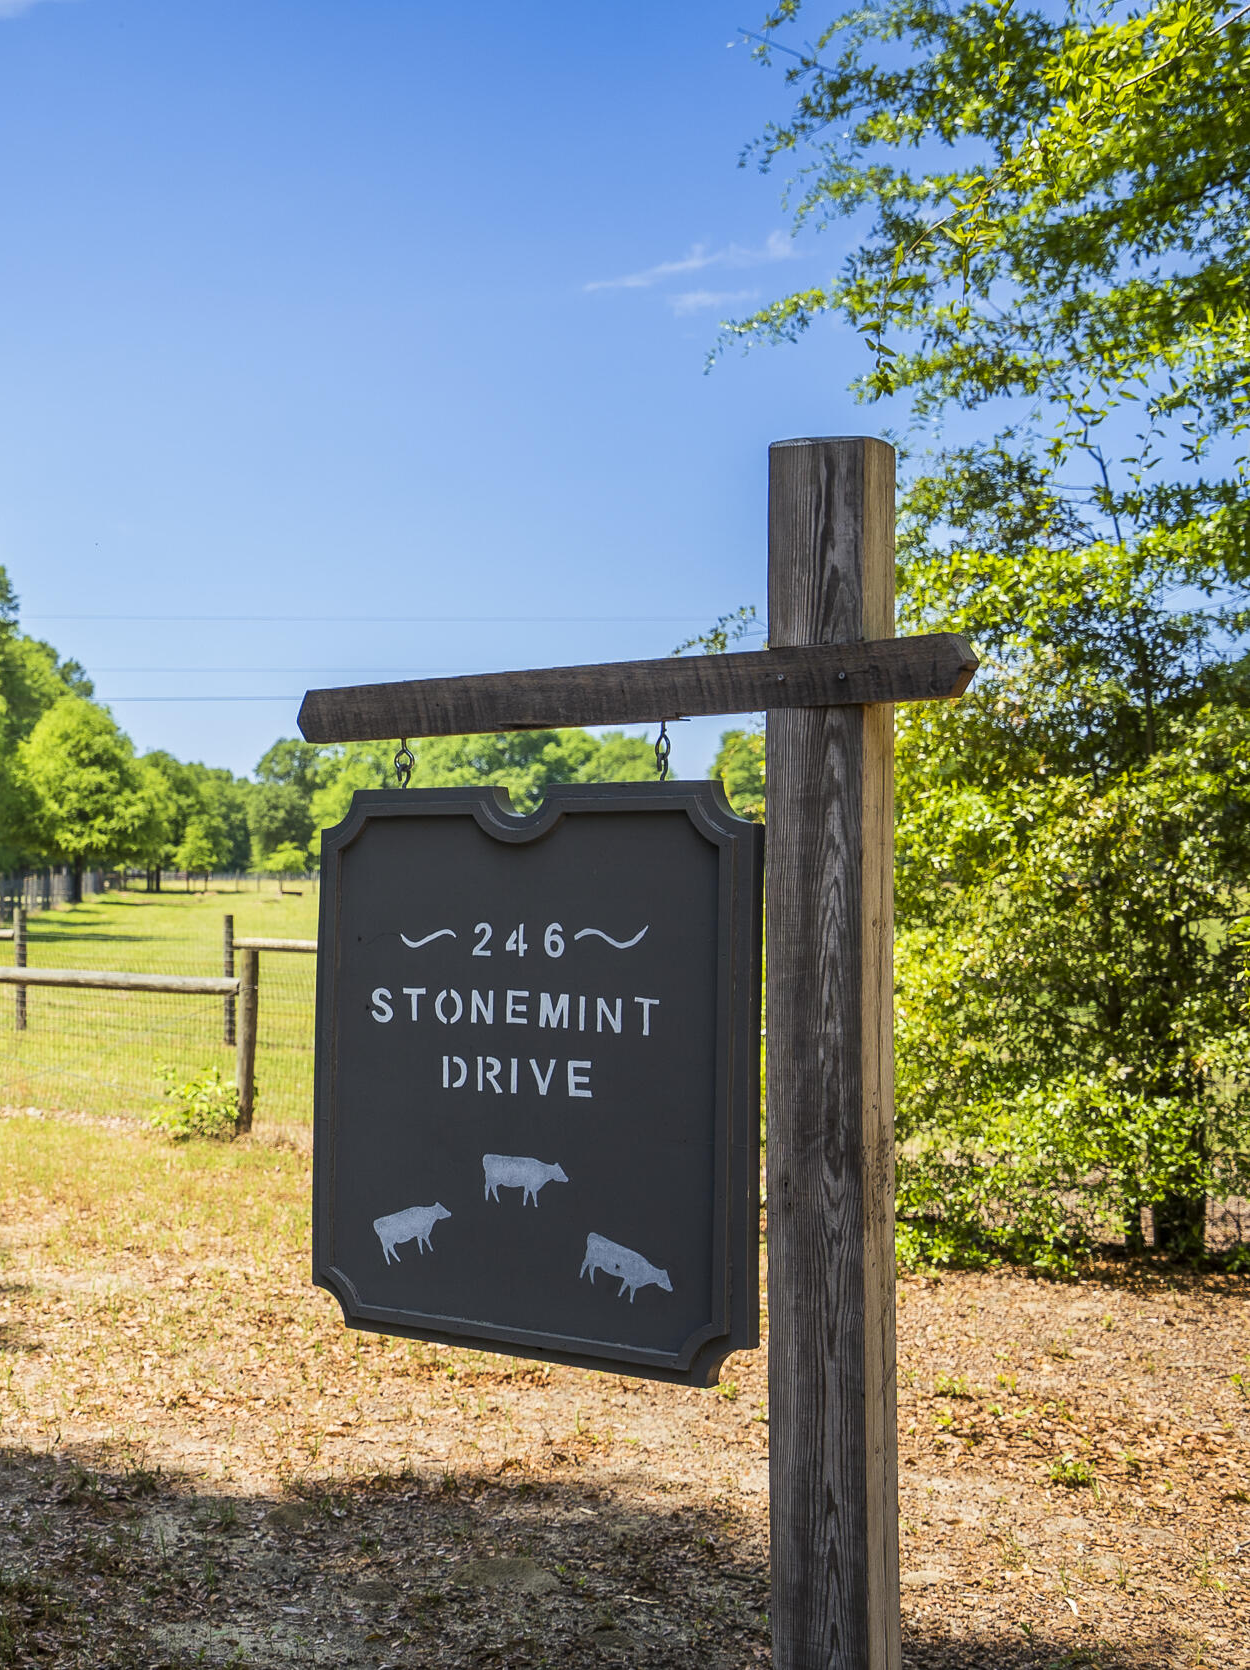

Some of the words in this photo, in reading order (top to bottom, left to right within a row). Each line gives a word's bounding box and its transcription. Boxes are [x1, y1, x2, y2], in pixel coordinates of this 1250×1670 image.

[472, 922, 565, 958] 246
[371, 987, 660, 1036] STONEMINT
[442, 1055, 593, 1098] DRIVE
